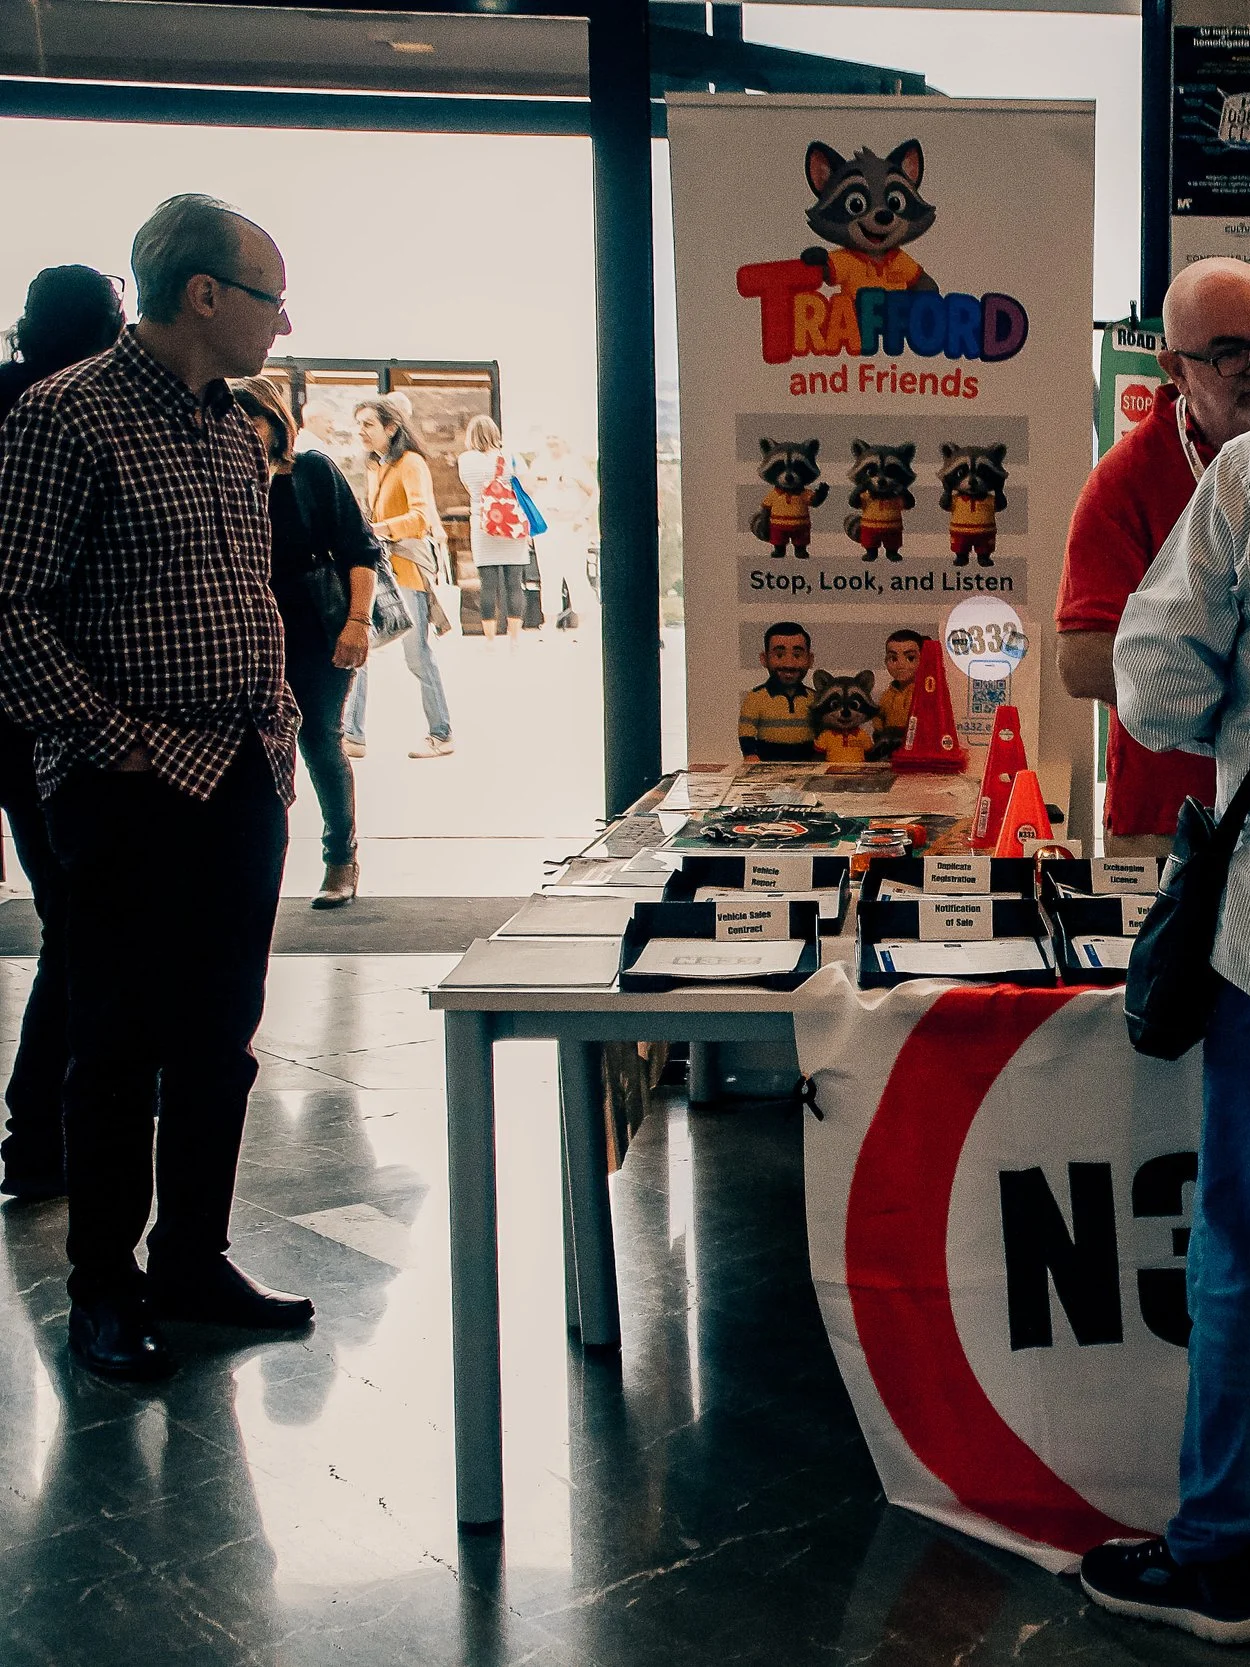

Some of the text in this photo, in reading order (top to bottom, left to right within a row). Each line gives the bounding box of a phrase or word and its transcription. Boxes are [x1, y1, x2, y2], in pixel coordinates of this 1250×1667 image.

[735, 258, 1030, 364] TRAFFORD
[1117, 328, 1156, 350] ROAD
[789, 362, 980, 400] and Friends
[1122, 396, 1153, 412] STOP
[749, 569, 1014, 595] Stop, Look, and Listen
[956, 721, 995, 732] n332.e
[752, 866, 780, 876] Vehicle
[937, 861, 972, 871] Duplicate
[751, 878, 777, 888] Report
[931, 874, 977, 884] Registration
[934, 903, 981, 913] Notification
[717, 910, 772, 922] Vehicle Sales
[945, 918, 974, 927] of Sale
[727, 924, 763, 935] Contract
